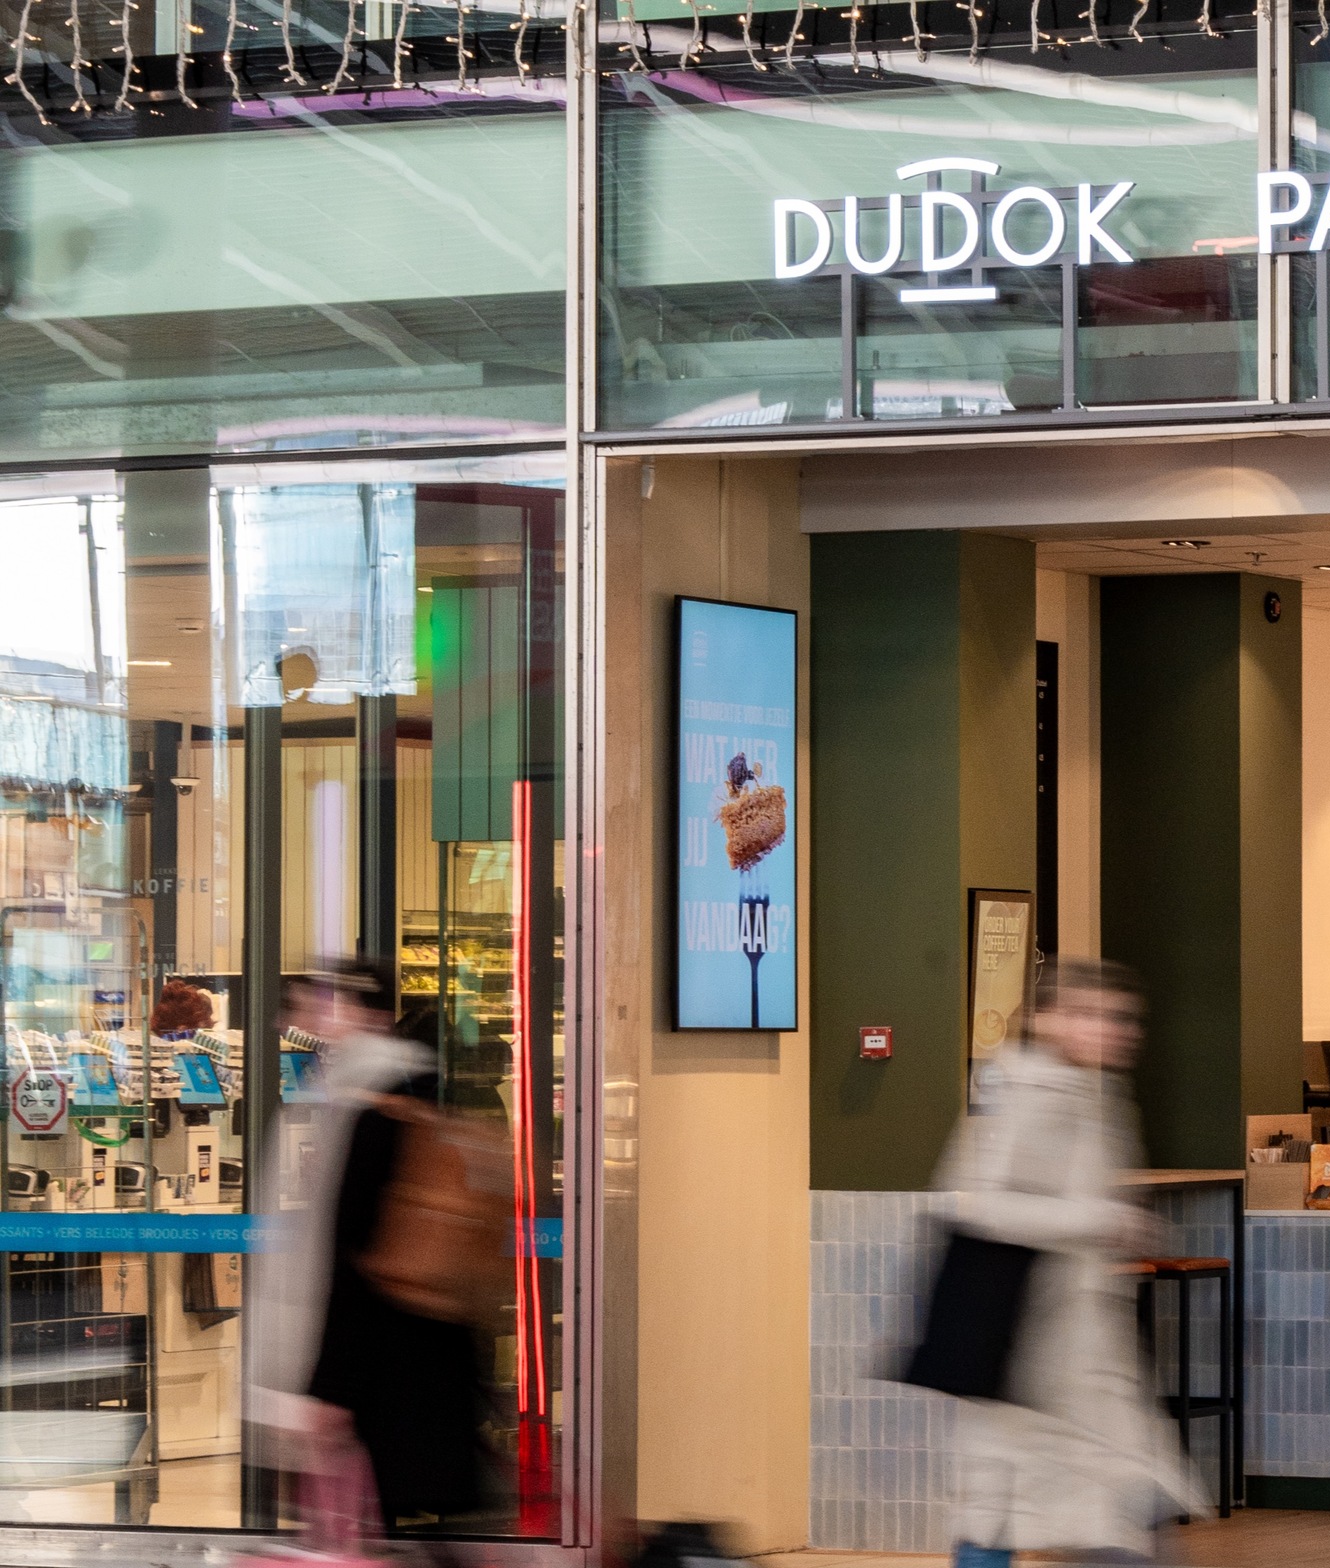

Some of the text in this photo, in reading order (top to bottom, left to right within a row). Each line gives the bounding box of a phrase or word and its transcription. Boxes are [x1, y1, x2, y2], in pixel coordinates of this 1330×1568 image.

[774, 181, 1136, 279] DUDOK
[684, 732, 729, 785] WAT
[684, 817, 708, 867] JIJ
[133, 878, 208, 894] KOFFIE
[684, 900, 791, 954] VANDAAG?
[139, 962, 207, 978] UNCH
[24, 1079, 53, 1091] STOP
[0, 1226, 44, 1239] SSANTS
[53, 1227, 81, 1239] VERS
[85, 1227, 135, 1240] BELEGDE
[139, 1228, 199, 1241] BROODJES
[210, 1229, 238, 1241] VERS
